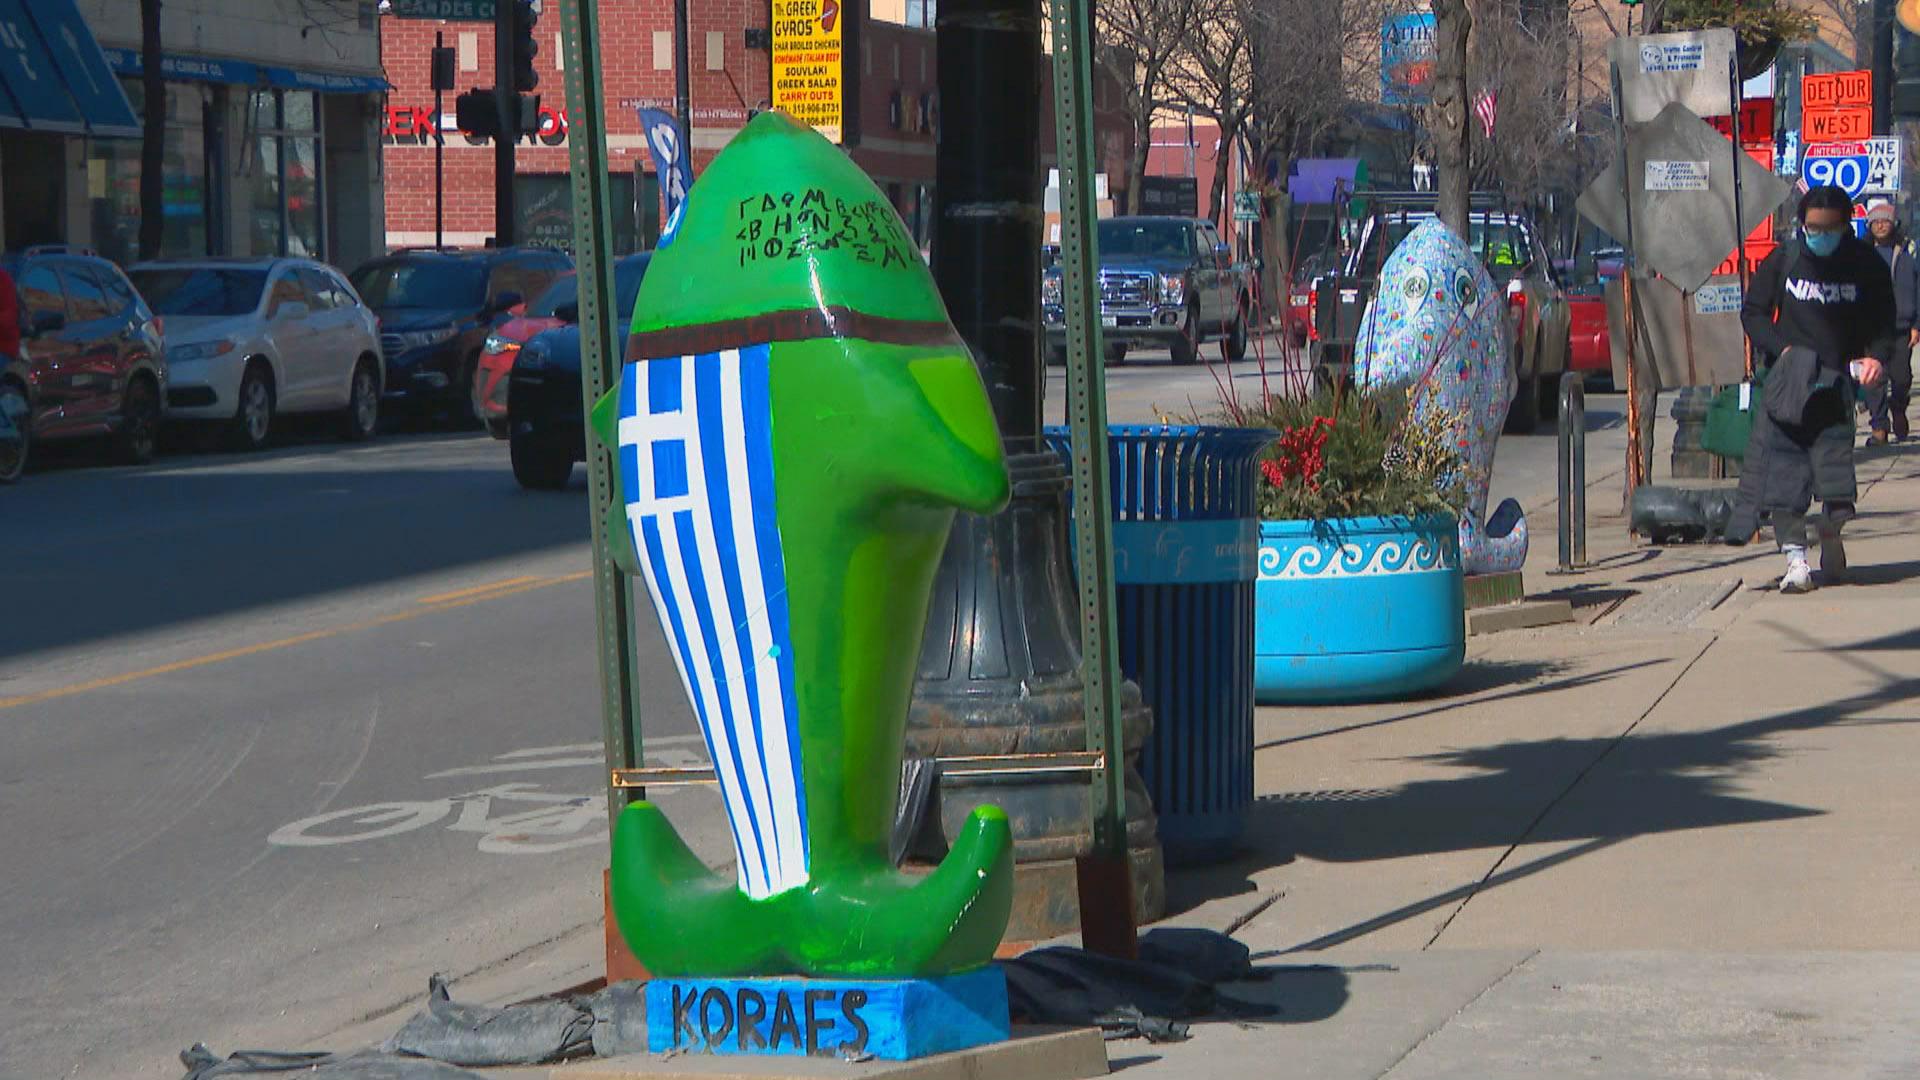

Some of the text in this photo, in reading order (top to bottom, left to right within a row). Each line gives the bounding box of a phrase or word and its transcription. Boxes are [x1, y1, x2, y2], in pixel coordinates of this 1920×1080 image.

[786, 1, 817, 17] GREEK
[775, 19, 813, 36] GYROS
[790, 41, 812, 51] BROILED
[814, 39, 840, 51] CHICKEN
[825, 53, 839, 62] BEEF
[785, 66, 828, 77] SOUVLAKI
[777, 77, 837, 90] GREEK SALAD
[1807, 78, 1867, 102] DETOUR
[780, 90, 834, 102] CARRY OUTS
[1813, 114, 1862, 135] WEST
[1813, 146, 1858, 157] INTERSTATE
[1809, 158, 1861, 192] 90
[671, 983, 869, 1058] KORAES
